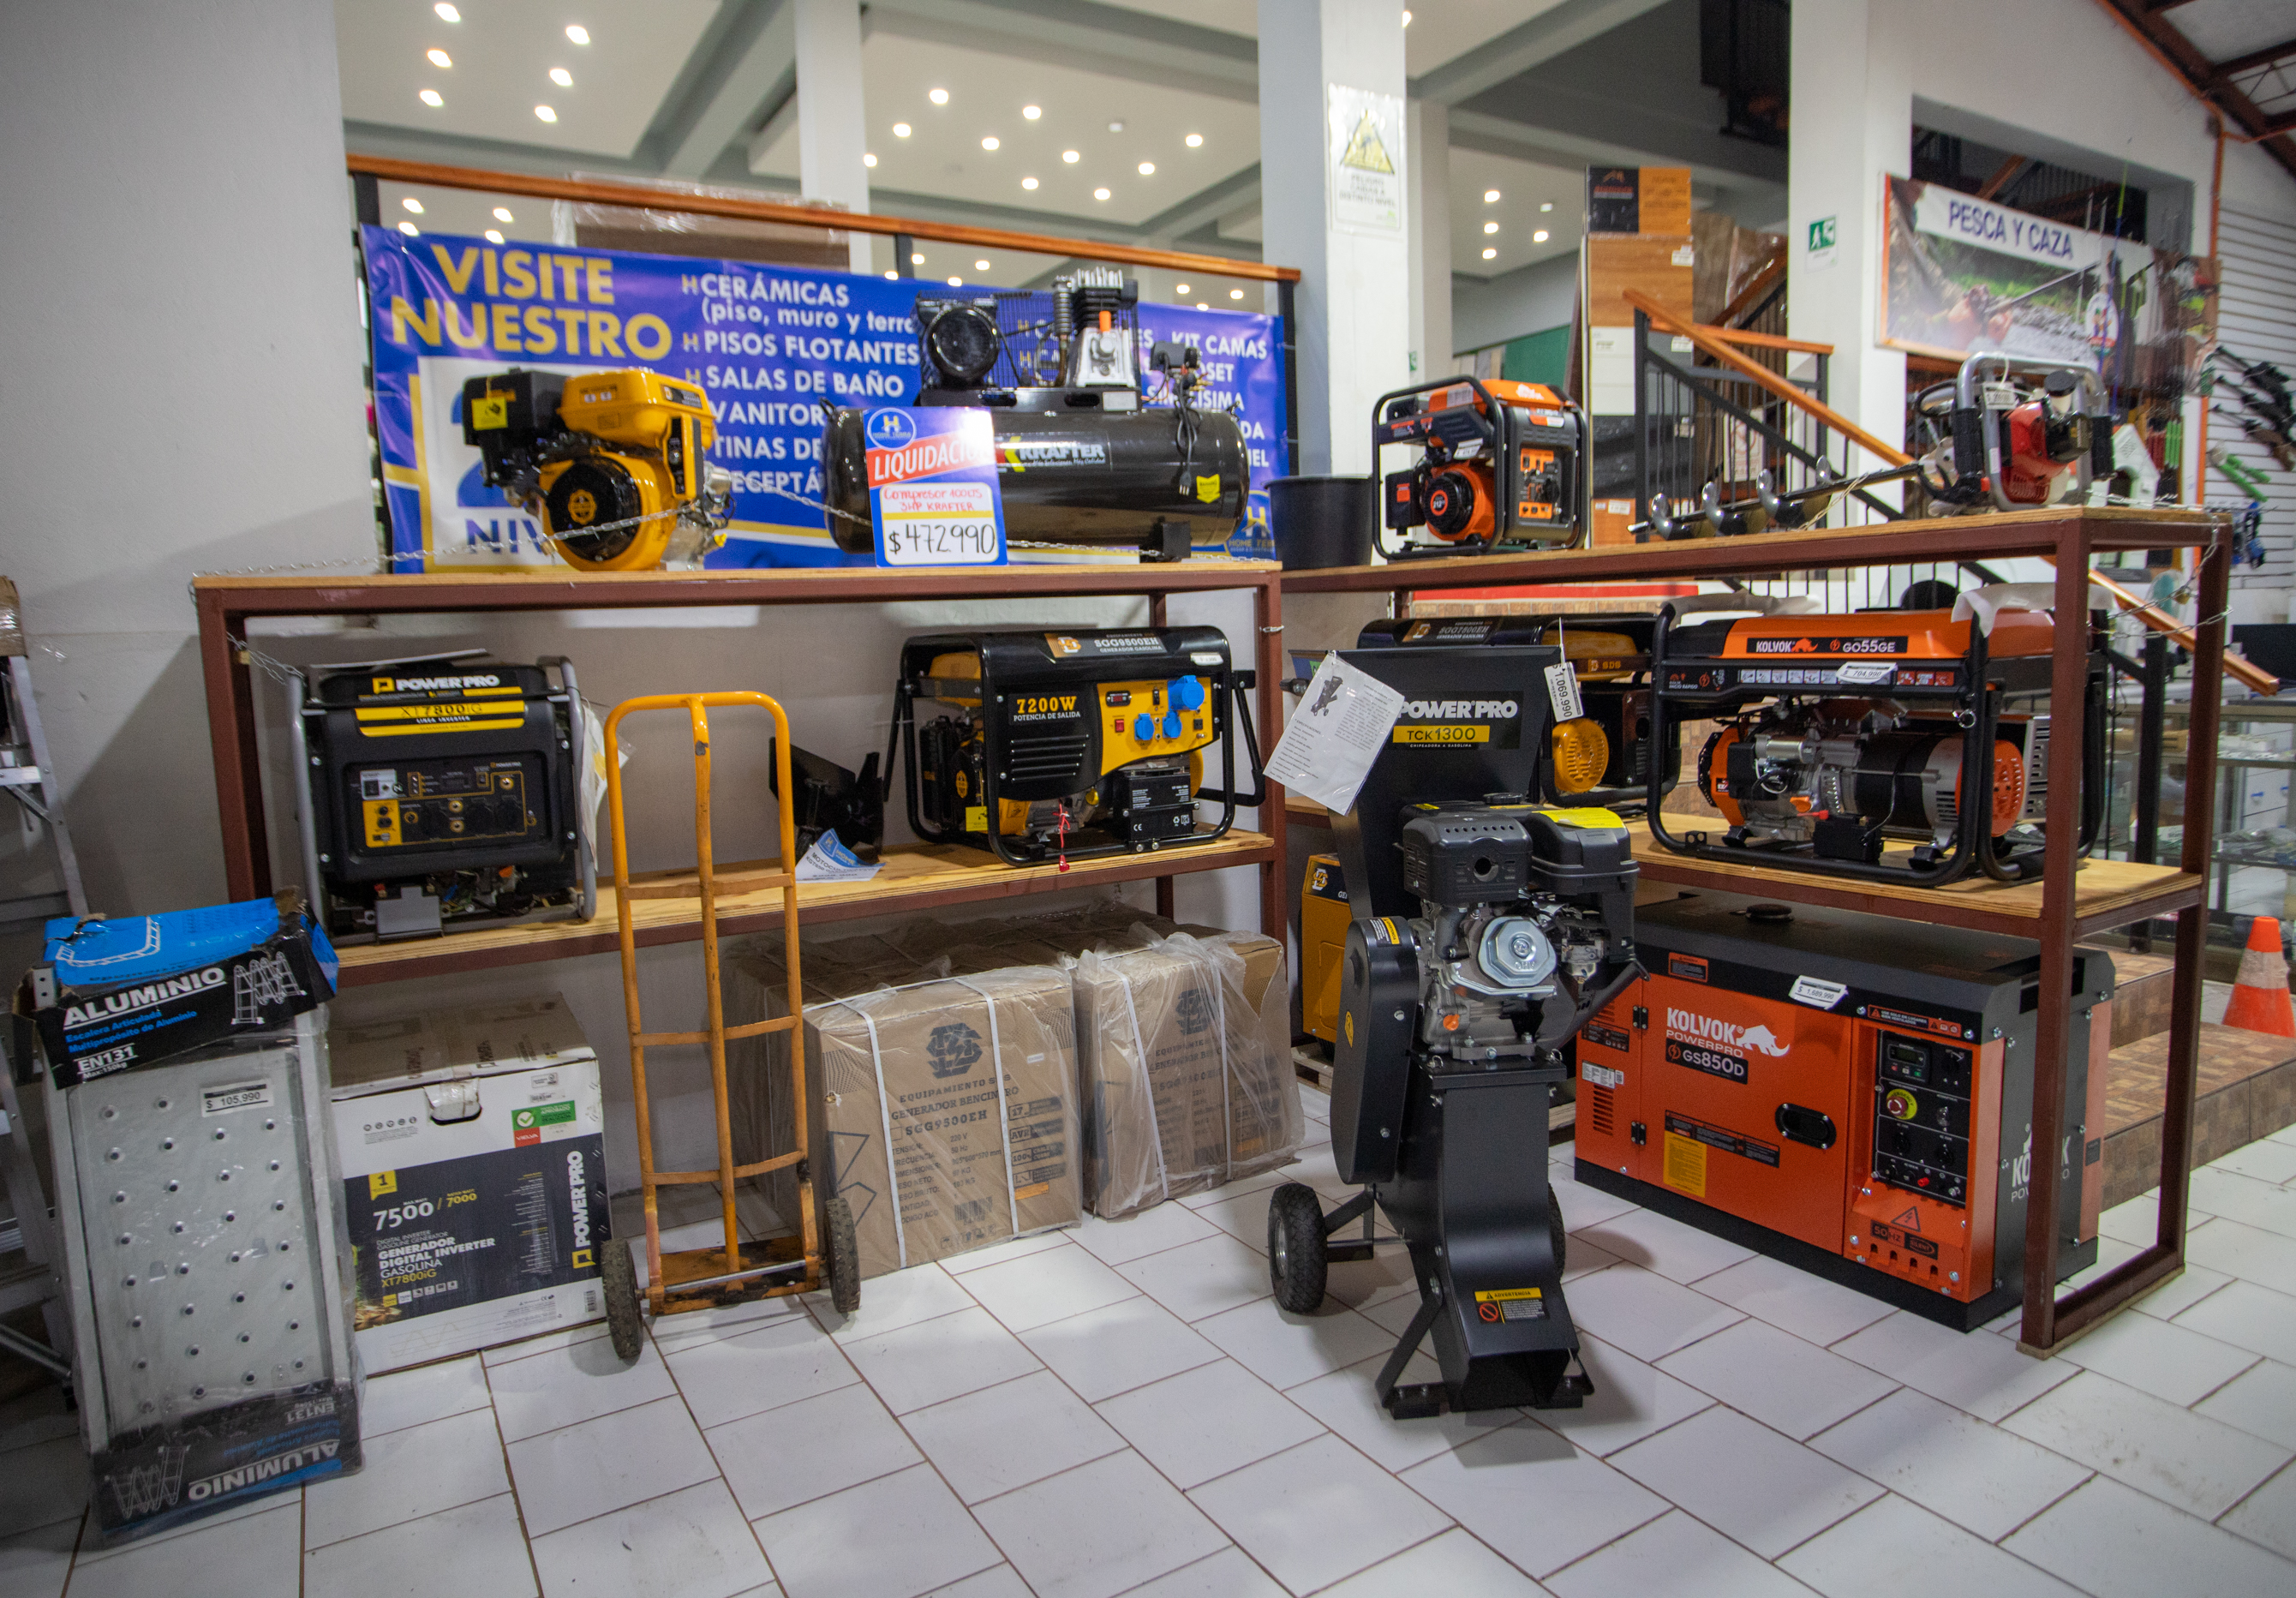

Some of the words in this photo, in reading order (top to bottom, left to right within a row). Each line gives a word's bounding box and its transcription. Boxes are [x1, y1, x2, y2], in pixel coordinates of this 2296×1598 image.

[1949, 200, 2007, 243] PESCA
[2012, 218, 2024, 247] Y
[2028, 223, 2073, 259] CAZA
[430, 243, 615, 305] VISITE
[700, 272, 850, 308] CERÁMICAS
[391, 296, 673, 360] NUESTRO
[702, 296, 770, 327] (piso,
[777, 308, 840, 329] muro
[846, 313, 861, 335] y
[704, 330, 779, 357] PISOS
[785, 334, 920, 366] FLOTANTES
[1205, 334, 1268, 360] CAMAS
[706, 365, 788, 392] SALAS
[794, 369, 826, 393] DE
[833, 369, 905, 398] BAÑO
[711, 400, 828, 427] VANITOR
[715, 435, 786, 459] TINAS
[1019, 443, 1105, 461] KRAFTER
[884, 488, 947, 506] Compresor
[927, 502, 975, 512] KRAFTER
[1094, 637, 1159, 648] SGG9500EH
[1756, 640, 1792, 653] KOLVOK
[1843, 639, 1896, 653] GO55GE
[1013, 714, 1047, 722] POTENCIA
[1057, 711, 1081, 720] SALIDA
[1016, 695, 1077, 715] 7200W
[64, 967, 225, 1026] ALUMINIO
[66, 1025, 111, 1043] Escalera
[111, 1010, 162, 1031] Articulada
[141, 1020, 154, 1032] de
[156, 1009, 197, 1028] Aluminio
[1666, 1007, 1737, 1045] KOLVOK
[1665, 1029, 1744, 1058] POWERPRO
[78, 1044, 135, 1072] EN131
[1683, 1049, 1744, 1076] GS850D
[900, 1078, 986, 1103] EQUIPAMIENTO
[989, 1073, 1012, 1085] SS
[891, 1099, 958, 1120] GENERADOR
[960, 1086, 1019, 1106] BENCINRO
[906, 1109, 988, 1136] SGG9500EH
[377, 1174, 388, 1186] 1
[899, 1179, 912, 1190] ESO
[900, 1191, 913, 1201] ESO
[373, 1201, 434, 1231] 7500
[446, 1193, 478, 1208] 7000
[378, 1236, 456, 1260] GENERADOR
[379, 1251, 433, 1270] DIGITAL
[434, 1237, 496, 1258] INVERTER
[380, 1258, 443, 1278] GASOLINA
[286, 1401, 336, 1423] EN131
[188, 1442, 341, 1501] ALUMINIO
